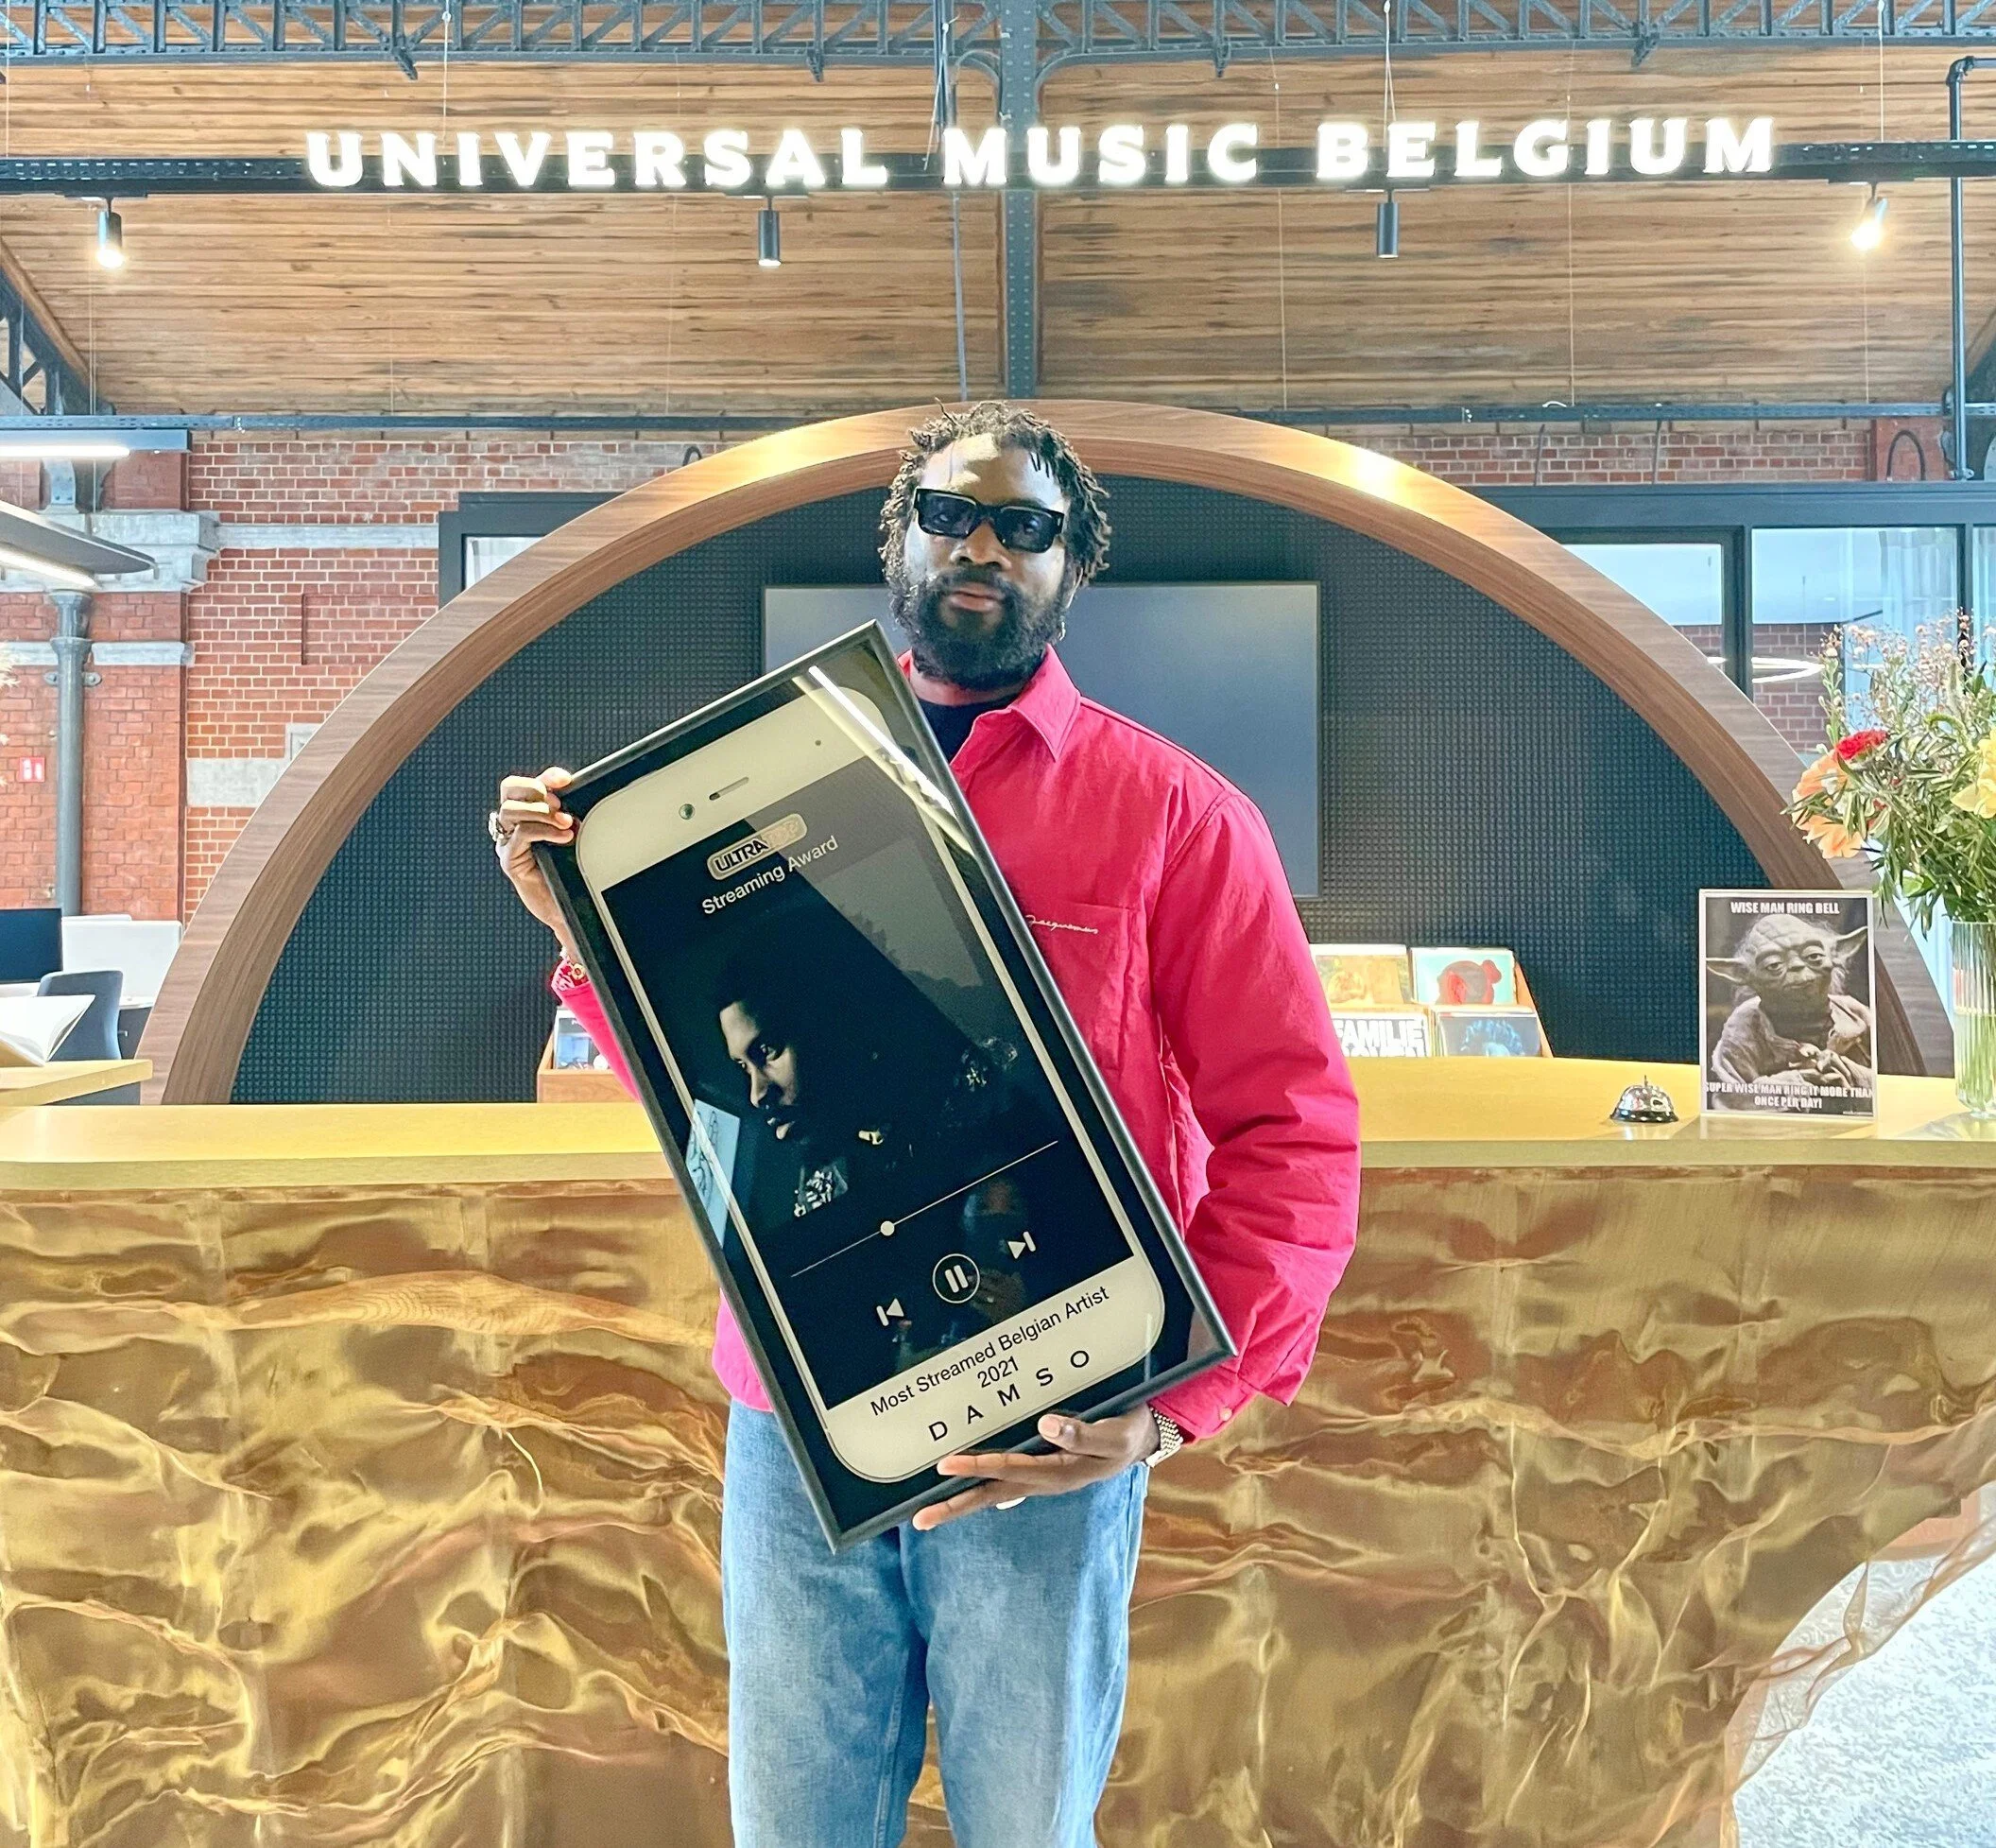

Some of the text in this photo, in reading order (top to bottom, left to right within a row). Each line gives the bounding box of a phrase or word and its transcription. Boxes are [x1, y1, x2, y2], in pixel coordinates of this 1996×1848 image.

[306, 116, 1774, 187] UNIVERSAL MUSIC BELGIUM
[701, 836, 839, 914] Streaming Award
[1730, 901, 1840, 914] WISE MAN RING BELL
[1734, 1083, 1759, 1094] WISE
[1761, 1084, 1782, 1095] MAN
[1783, 1085, 1807, 1096] RING
[1809, 1085, 1819, 1097] IT
[1819, 1086, 1849, 1097] MORE
[1754, 1096, 1823, 1109] ONCE PER DAY!
[870, 1287, 1110, 1416] Most Streamed Belgian Artist
[977, 1356, 1020, 1389] 2021
